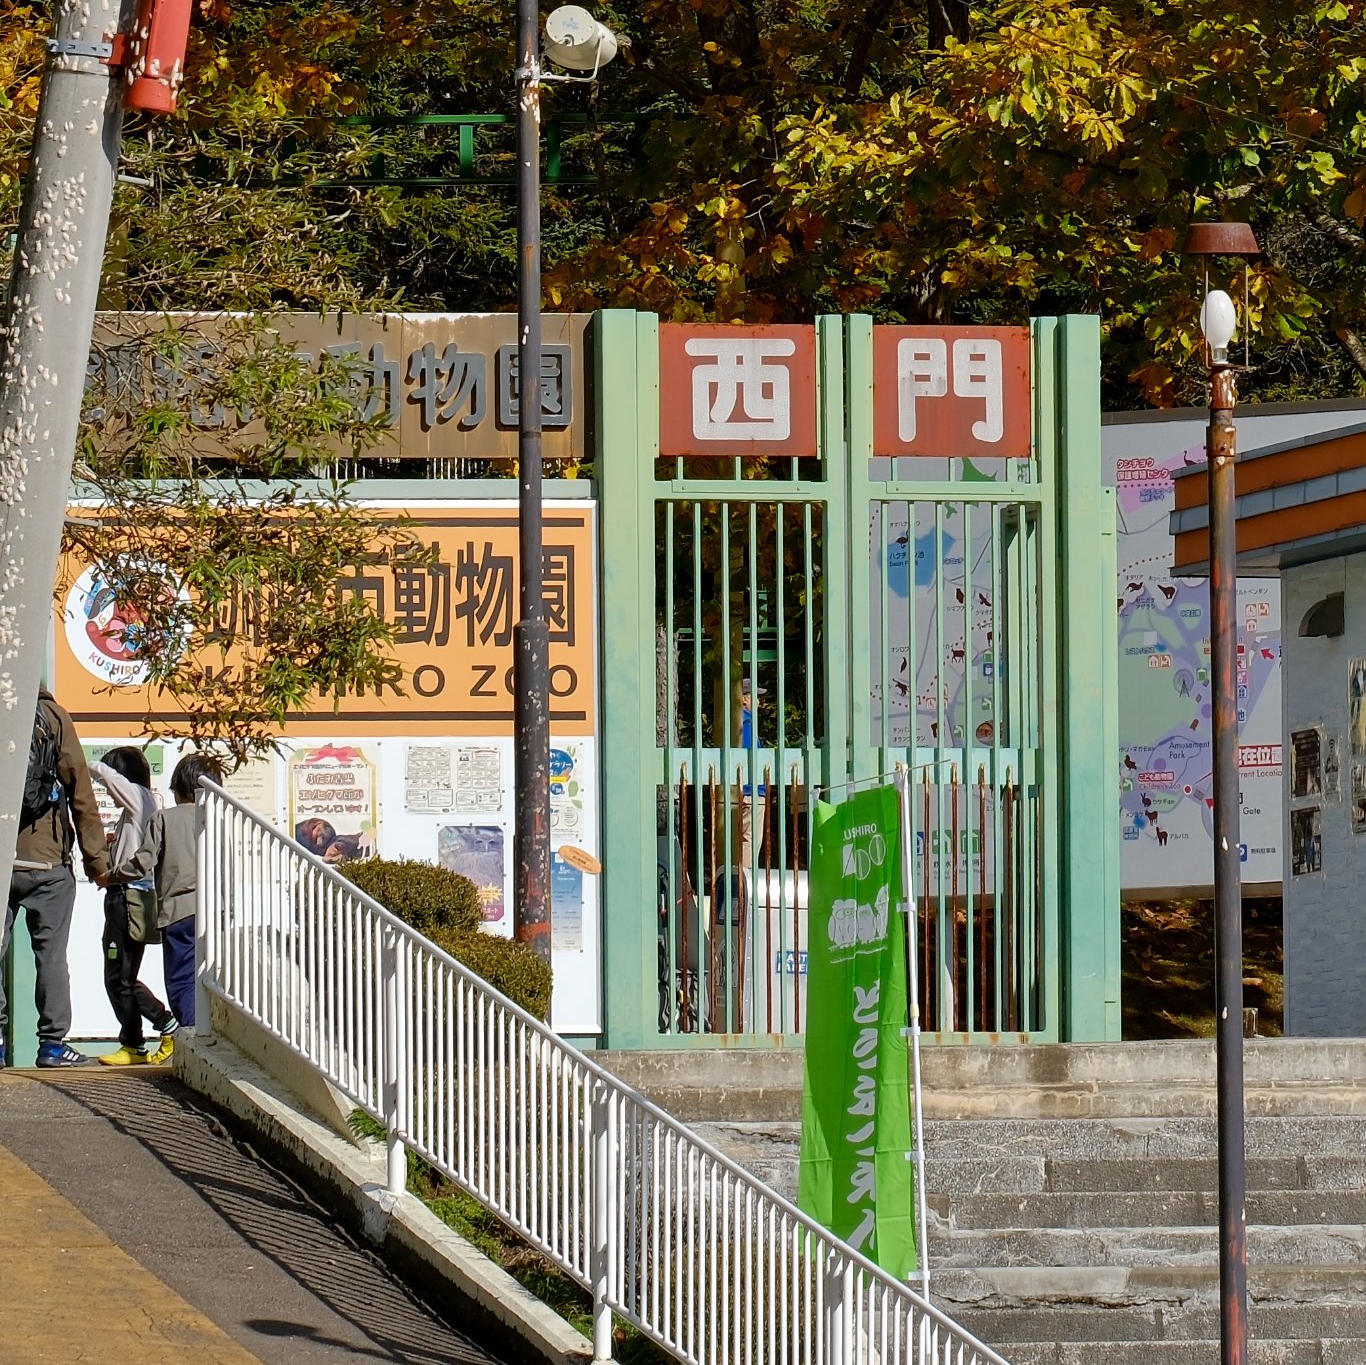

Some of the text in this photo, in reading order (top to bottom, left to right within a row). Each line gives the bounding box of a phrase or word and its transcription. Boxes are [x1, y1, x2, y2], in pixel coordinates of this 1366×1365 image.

[684, 338, 1003, 443] 西門
[1117, 457, 1154, 469] タンチョウ
[1169, 741, 1210, 749] Amusement
[1169, 750, 1185, 759] Park
[1243, 806, 1261, 815] Gate
[842, 823, 877, 842] USHIRO
